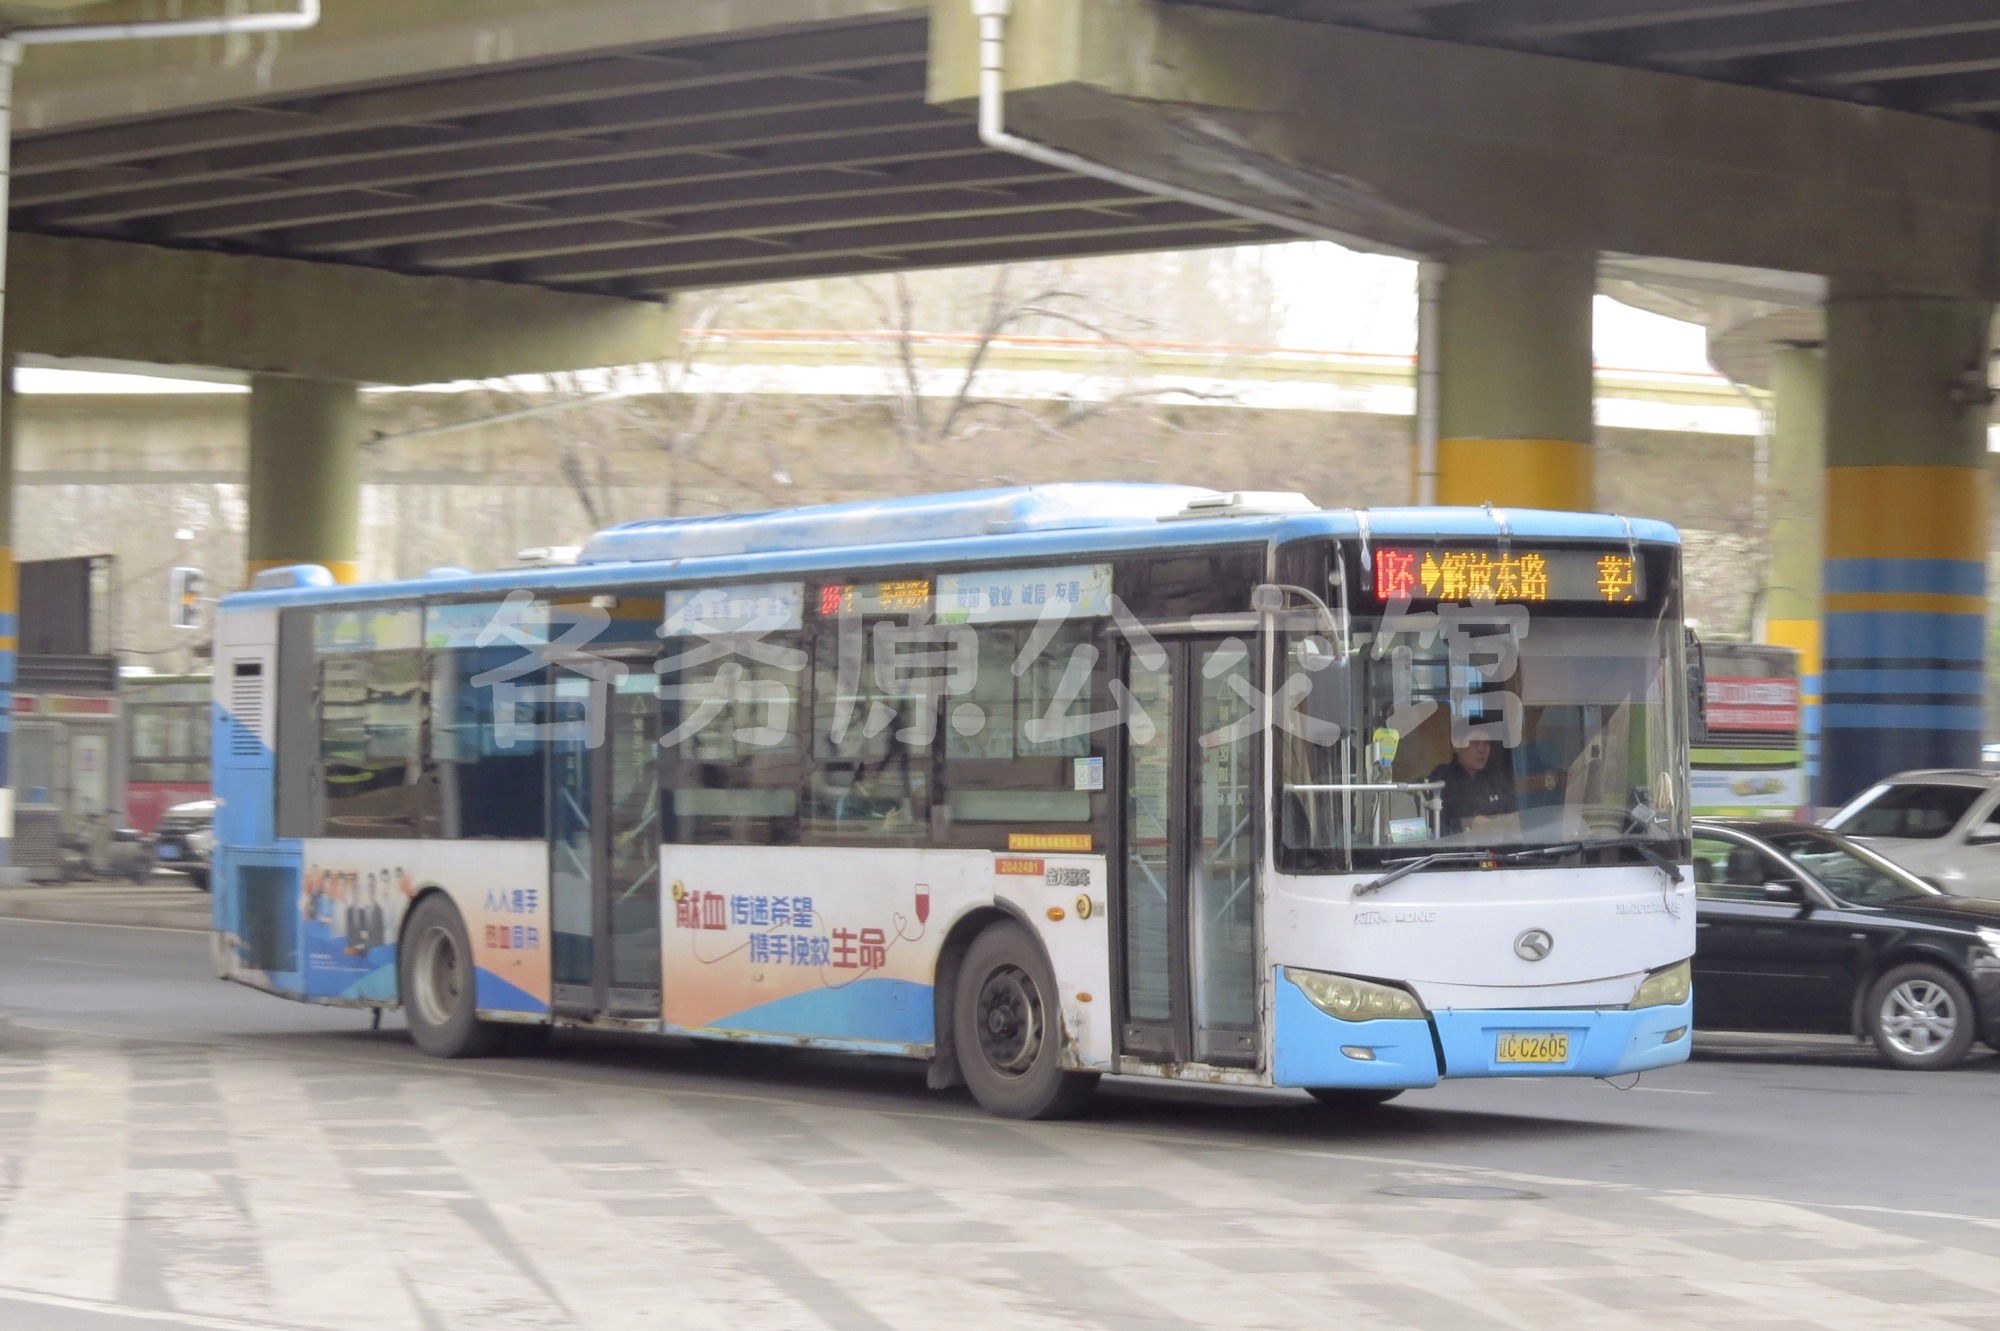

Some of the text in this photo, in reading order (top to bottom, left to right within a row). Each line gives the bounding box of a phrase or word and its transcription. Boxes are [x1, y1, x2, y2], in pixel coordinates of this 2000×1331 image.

[1021, 583, 1046, 605] 诚信
[1055, 581, 1080, 603] 友善
[1440, 551, 1548, 600] 解放东路
